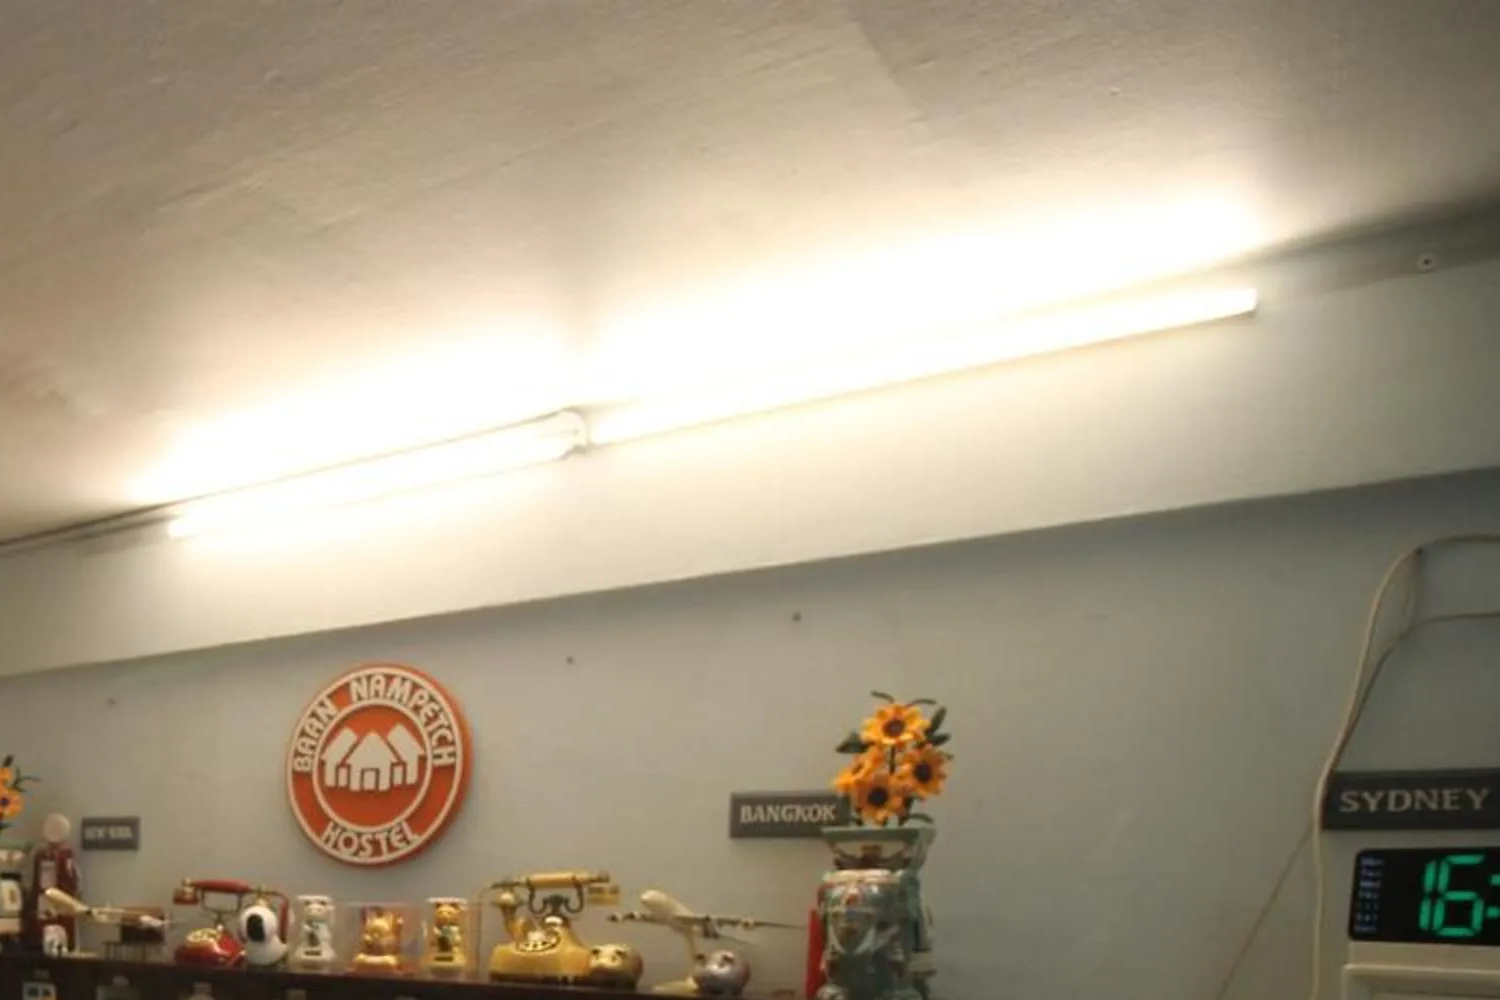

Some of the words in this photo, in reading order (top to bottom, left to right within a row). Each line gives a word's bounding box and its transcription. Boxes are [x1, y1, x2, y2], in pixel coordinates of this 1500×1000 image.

[293, 695, 340, 773] BAAN
[350, 673, 456, 768] NAMPETCH
[740, 803, 837, 823] BANGKOK
[1339, 787, 1492, 814] SYDNEY
[321, 819, 423, 858] HOSTEL
